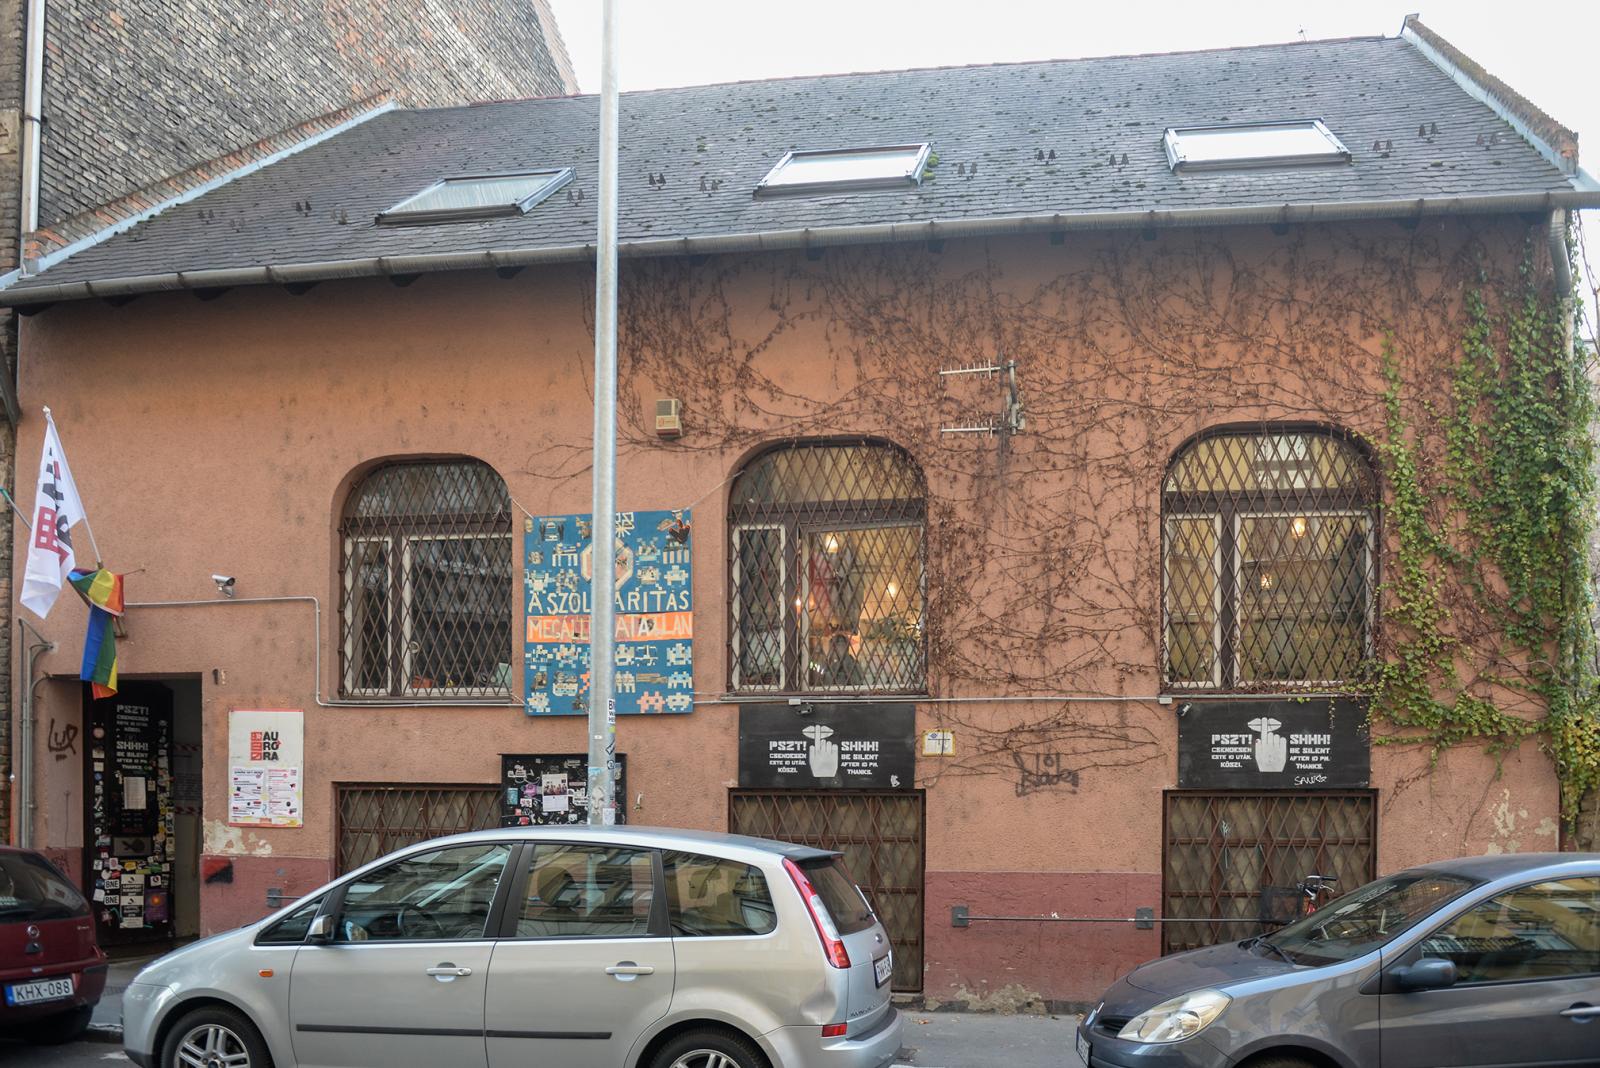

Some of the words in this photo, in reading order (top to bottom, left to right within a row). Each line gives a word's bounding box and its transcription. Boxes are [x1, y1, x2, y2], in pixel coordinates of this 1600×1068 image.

[263, 731, 279, 741] AU
[1211, 734, 1252, 745] PSZT!
[1289, 734, 1331, 745] SHHH!
[263, 742, 279, 751] RO
[769, 741, 807, 751] PSZT!
[840, 741, 880, 752] SHHH!
[263, 752, 279, 761] RA
[105, 880, 119, 889] BNE
[105, 896, 118, 904] BNE
[15, 981, 71, 1002] KHX-088
